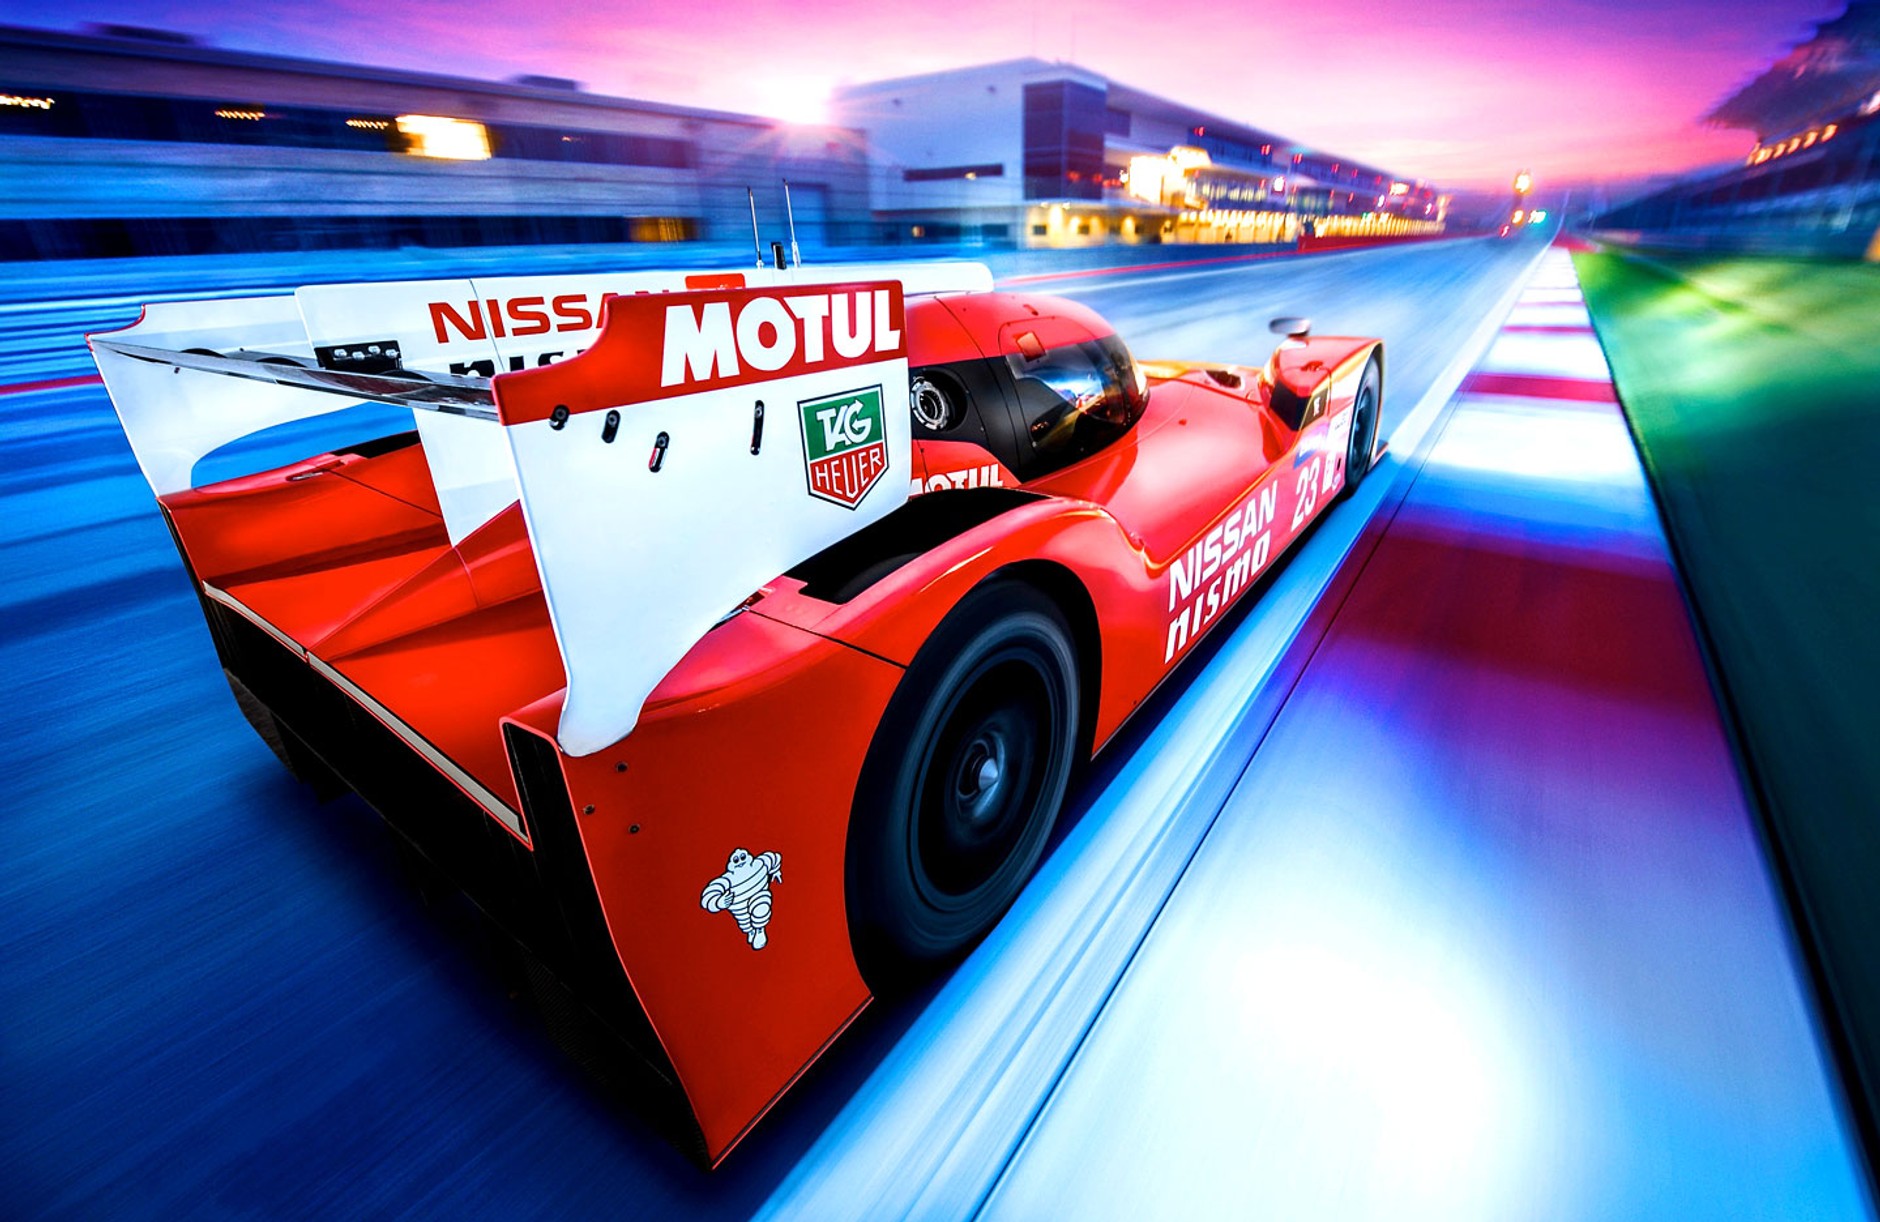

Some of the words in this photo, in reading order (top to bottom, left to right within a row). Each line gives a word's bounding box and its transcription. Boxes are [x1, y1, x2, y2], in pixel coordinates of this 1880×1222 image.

[428, 289, 669, 344] NISS
[661, 289, 901, 388] MOTUL
[816, 399, 872, 452] TAG
[815, 447, 882, 498] HEUER
[1291, 456, 1322, 533] 23
[1168, 480, 1278, 614] NISSAN
